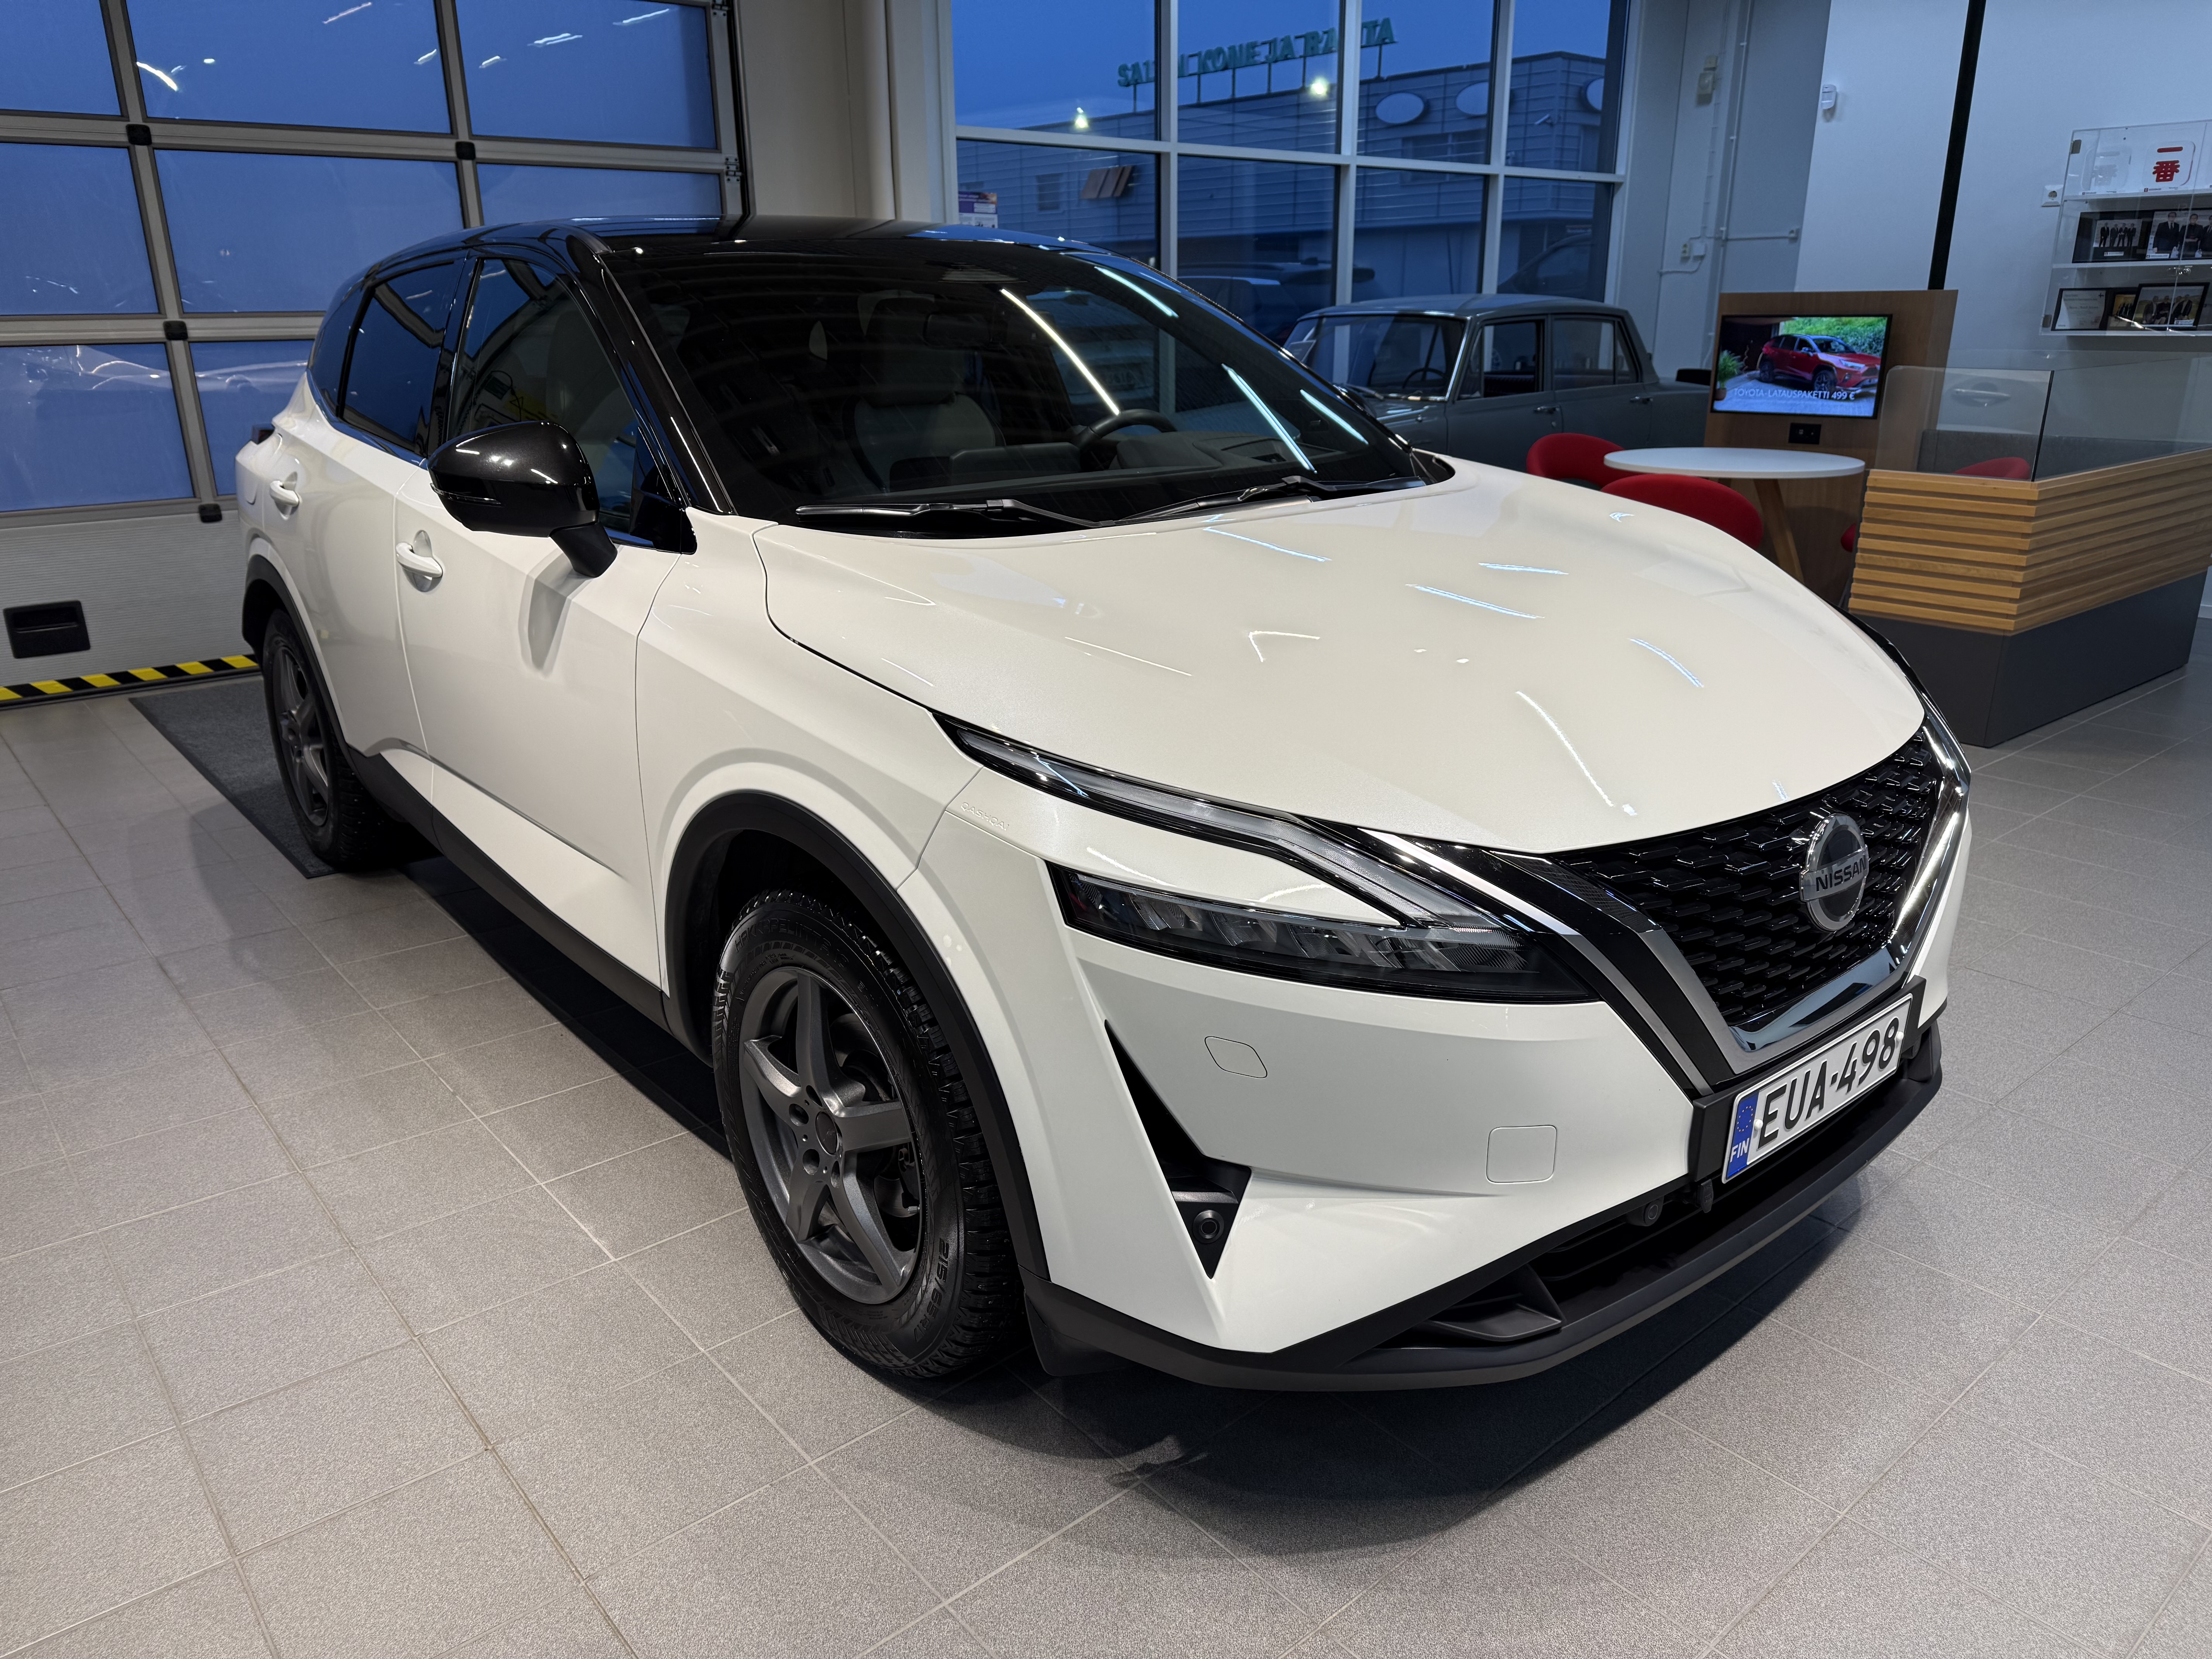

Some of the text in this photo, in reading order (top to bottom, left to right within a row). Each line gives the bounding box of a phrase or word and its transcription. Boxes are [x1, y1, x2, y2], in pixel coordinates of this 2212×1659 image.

[1118, 17, 1394, 87] SALN KONE JA RATA
[2152, 146, 2183, 182] 一番
[1831, 391, 1847, 400] 499
[1849, 392, 1855, 400] €
[961, 802, 1010, 831] QASHQAI
[1816, 854, 1866, 892] NISSAN
[1757, 1017, 1899, 1150] EUA-498
[1730, 1138, 1750, 1163] FIN
